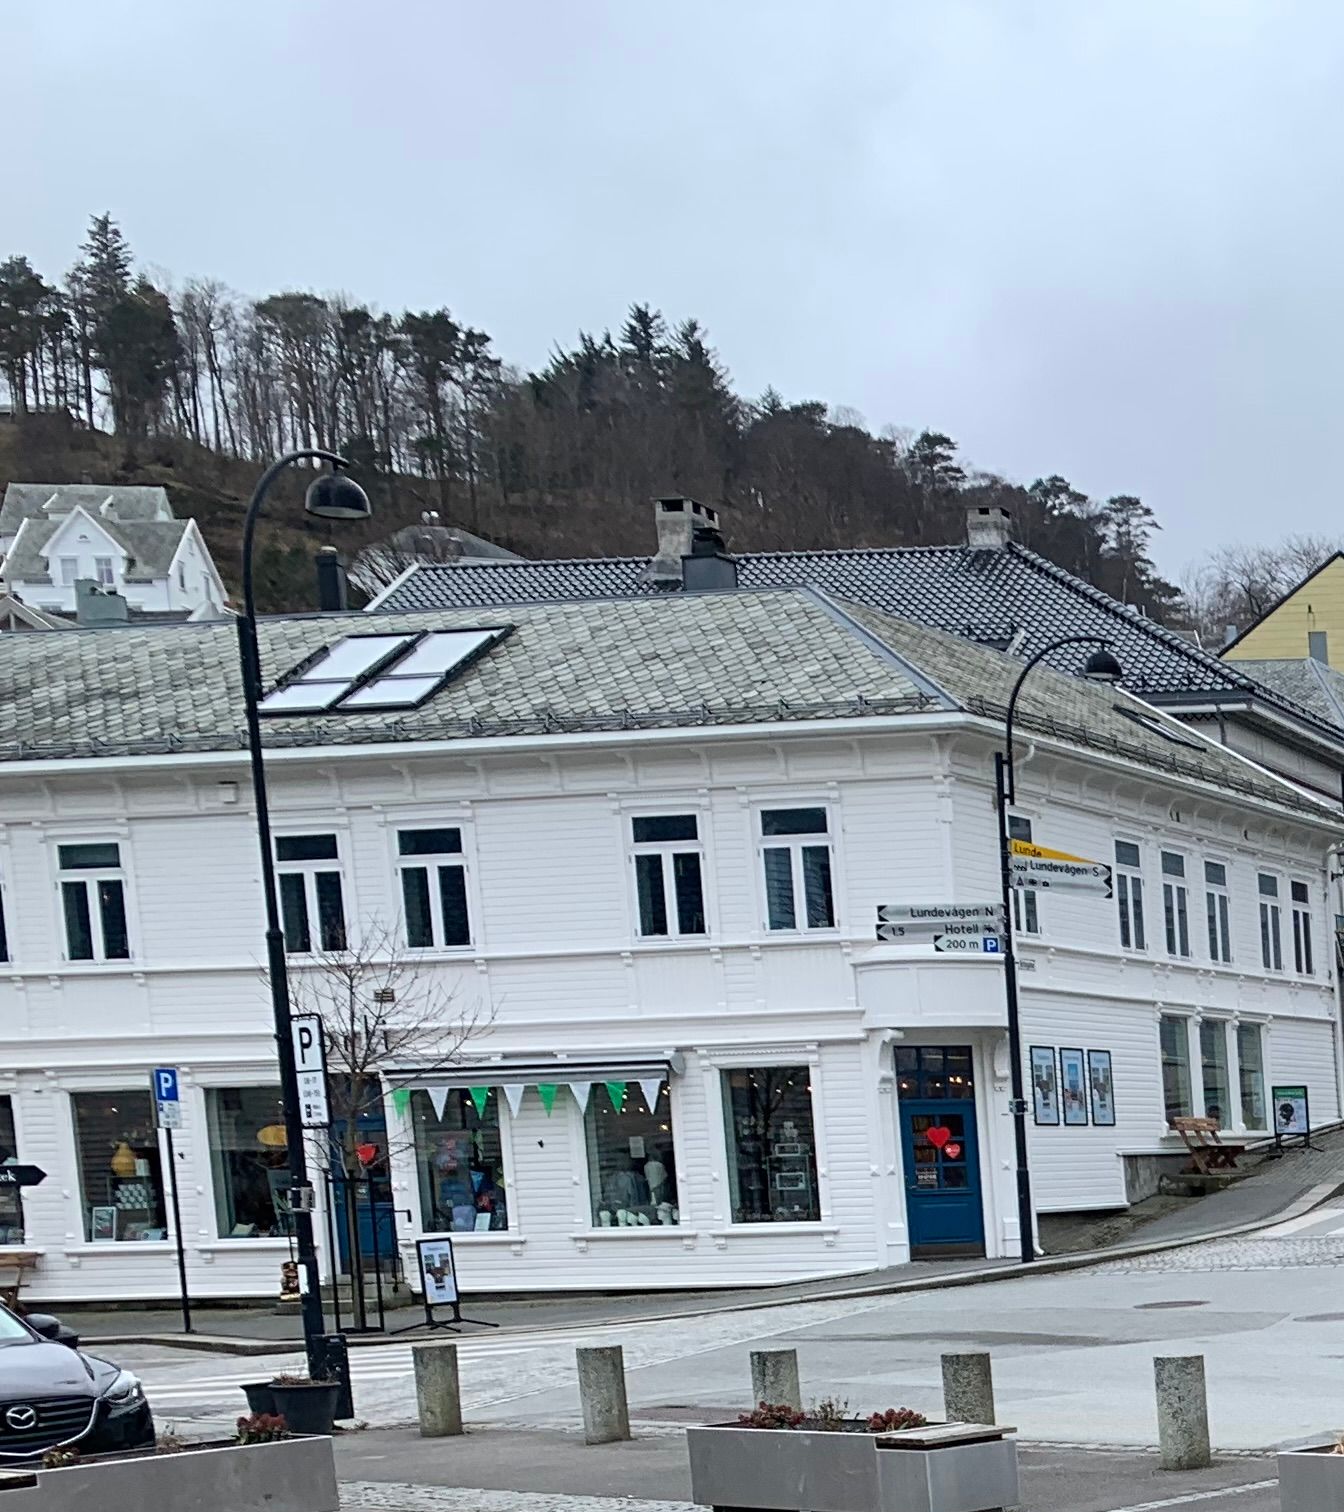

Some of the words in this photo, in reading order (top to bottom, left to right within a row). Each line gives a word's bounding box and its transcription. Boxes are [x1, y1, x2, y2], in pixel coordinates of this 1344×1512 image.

[1014, 841, 1042, 858] Lunde
[1030, 860, 1088, 876] Lundevågen
[1092, 867, 1099, 877] S
[910, 906, 979, 919] Lundevågen
[985, 906, 994, 917] N
[945, 924, 979, 935] Hotell
[946, 939, 966, 949] 200
[969, 940, 979, 949] m
[987, 939, 997, 951] P
[298, 1027, 312, 1064] P
[159, 1072, 173, 1097] P
